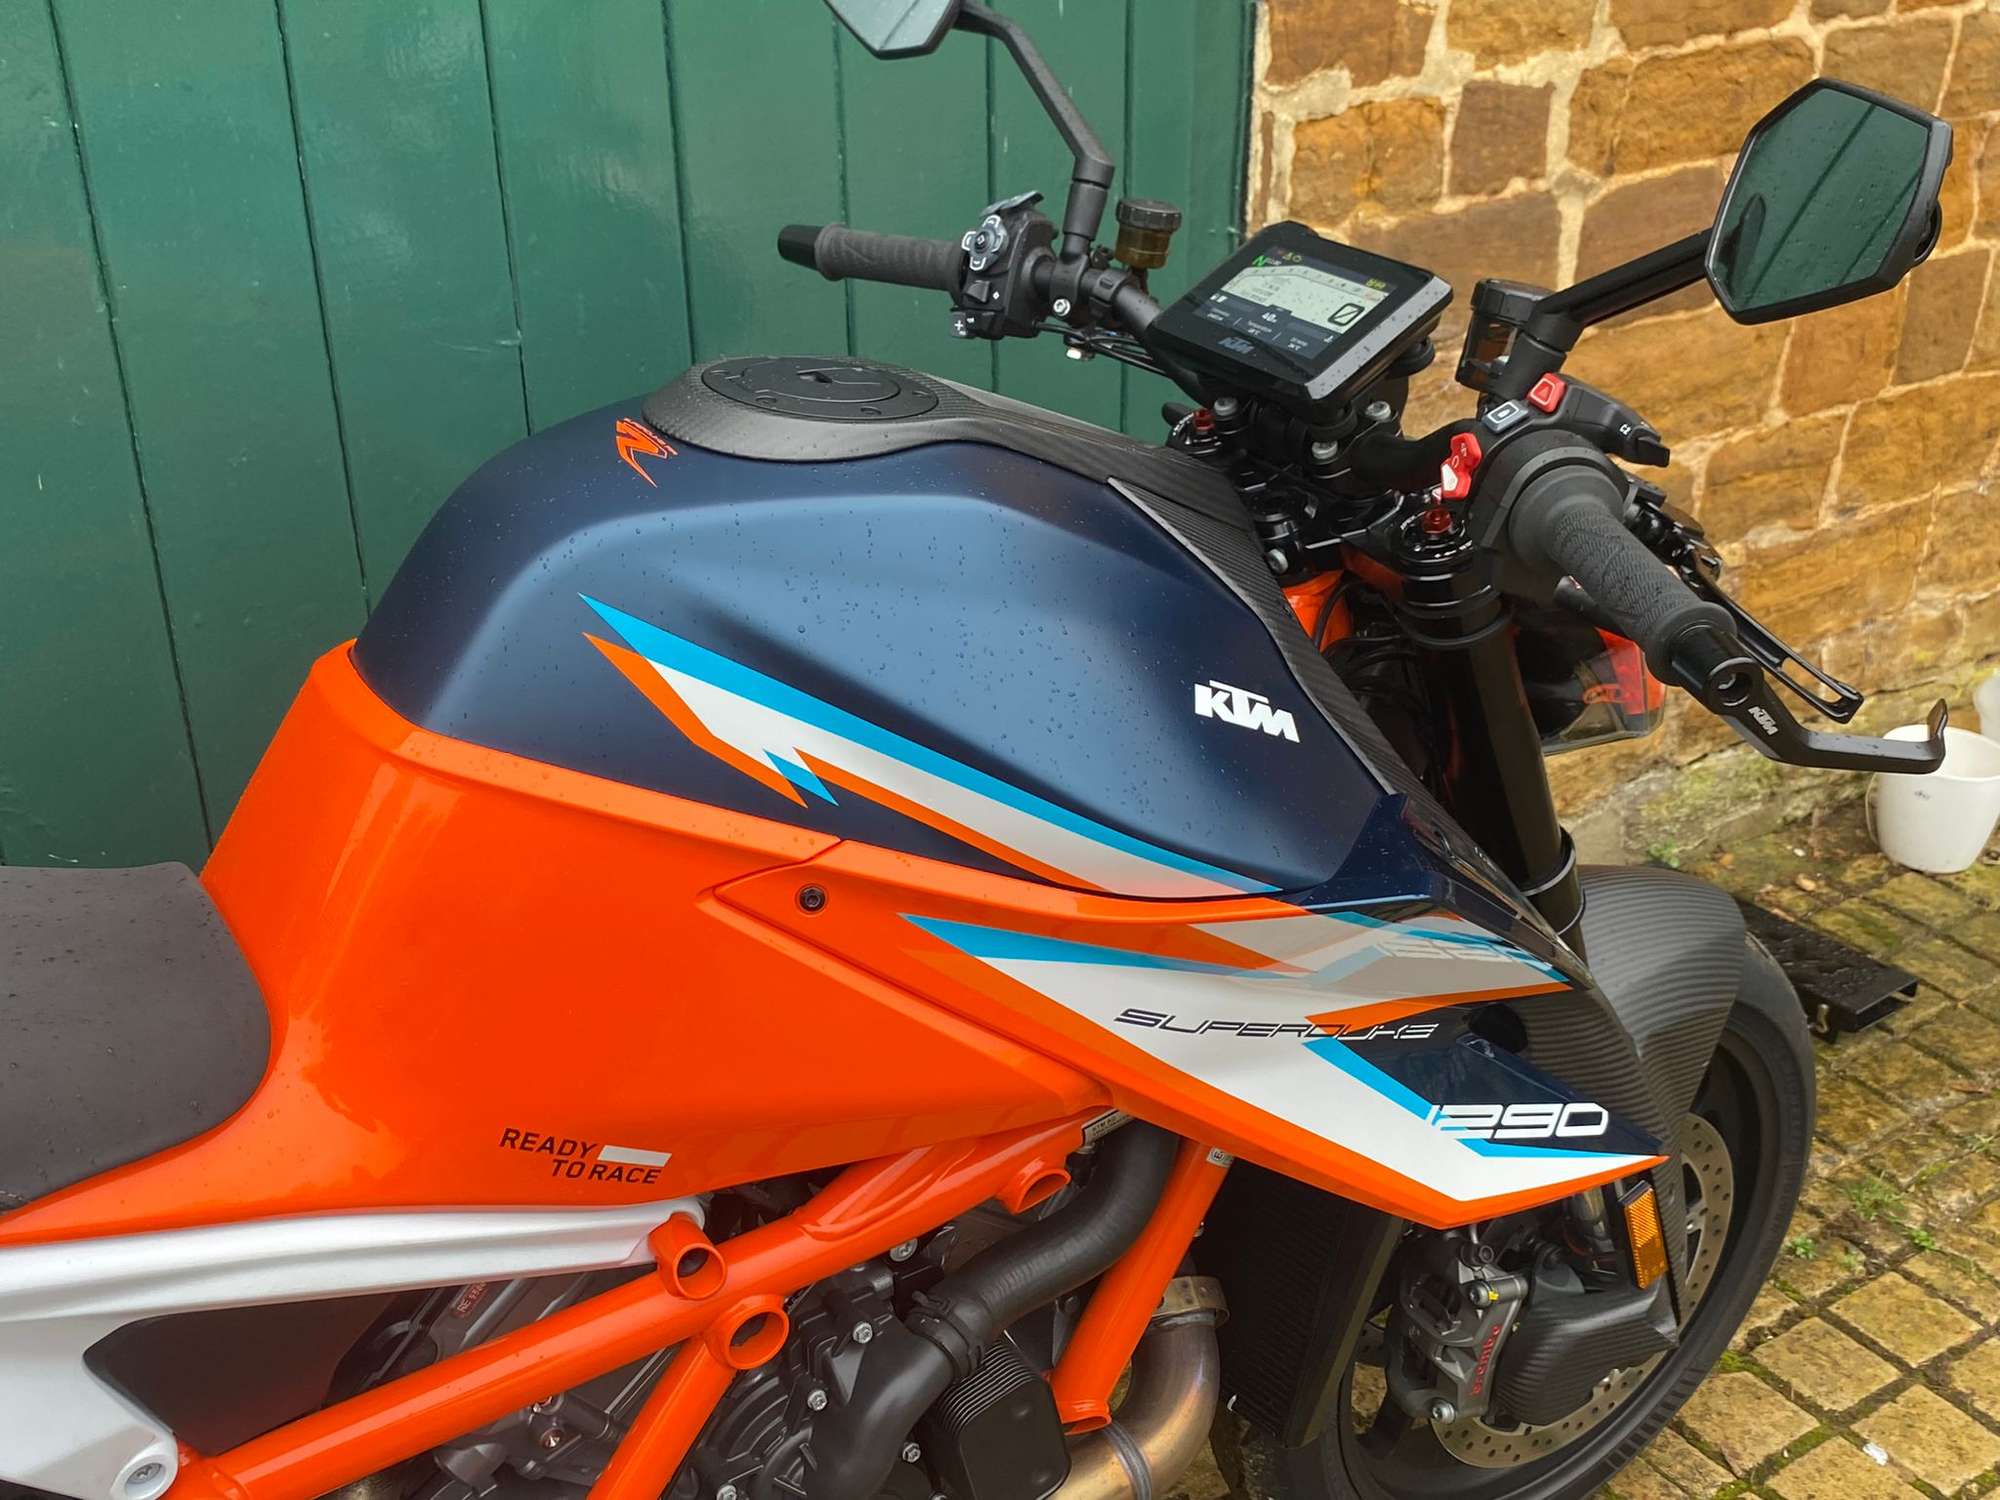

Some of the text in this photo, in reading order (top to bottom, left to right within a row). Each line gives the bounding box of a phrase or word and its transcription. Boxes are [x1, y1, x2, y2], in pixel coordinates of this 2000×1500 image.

[1217, 336, 1255, 354] KTM
[1194, 679, 1301, 744] KTM
[1747, 705, 1780, 736] KTM
[1424, 1102, 1609, 1139] 1290
[500, 1127, 598, 1159] READY
[552, 1158, 662, 1185] TO RACE
